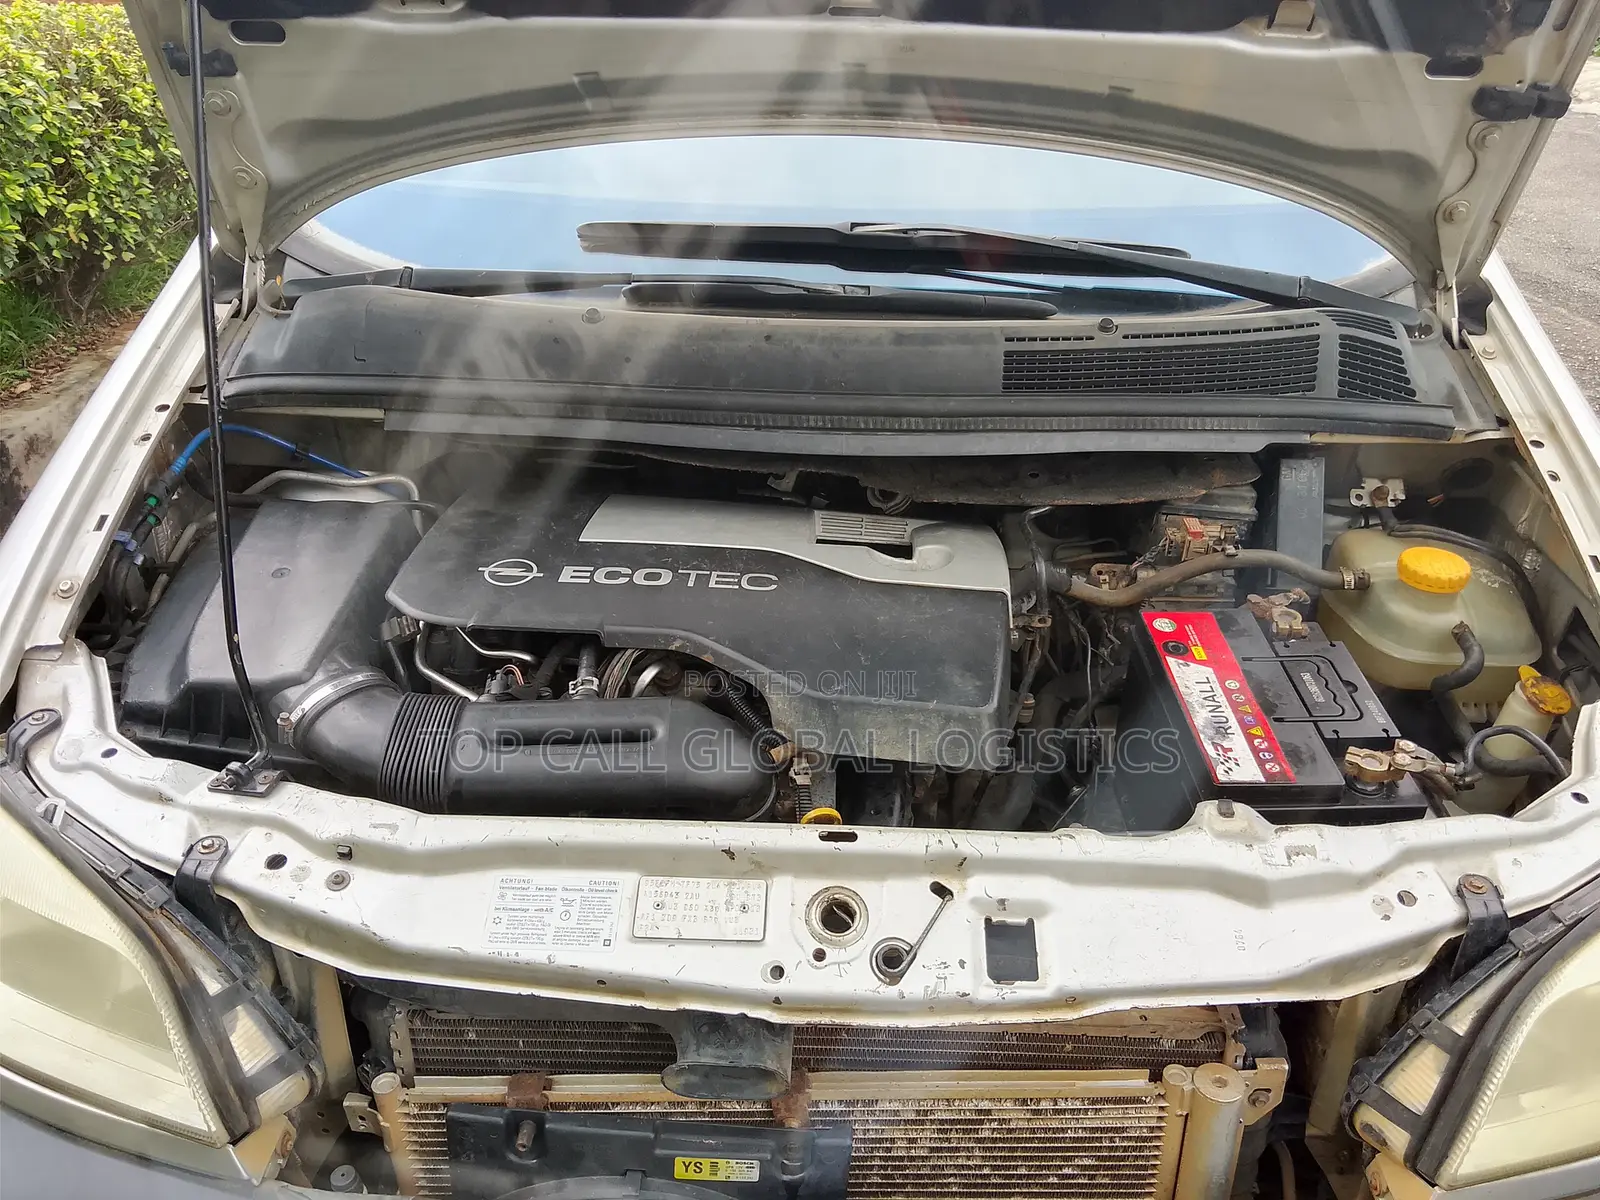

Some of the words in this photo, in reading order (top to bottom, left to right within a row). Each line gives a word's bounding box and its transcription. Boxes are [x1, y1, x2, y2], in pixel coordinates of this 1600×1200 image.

[557, 565, 778, 591] ECOTEC
[1195, 676, 1236, 736] RUNALL
[681, 1160, 704, 1174] YS
